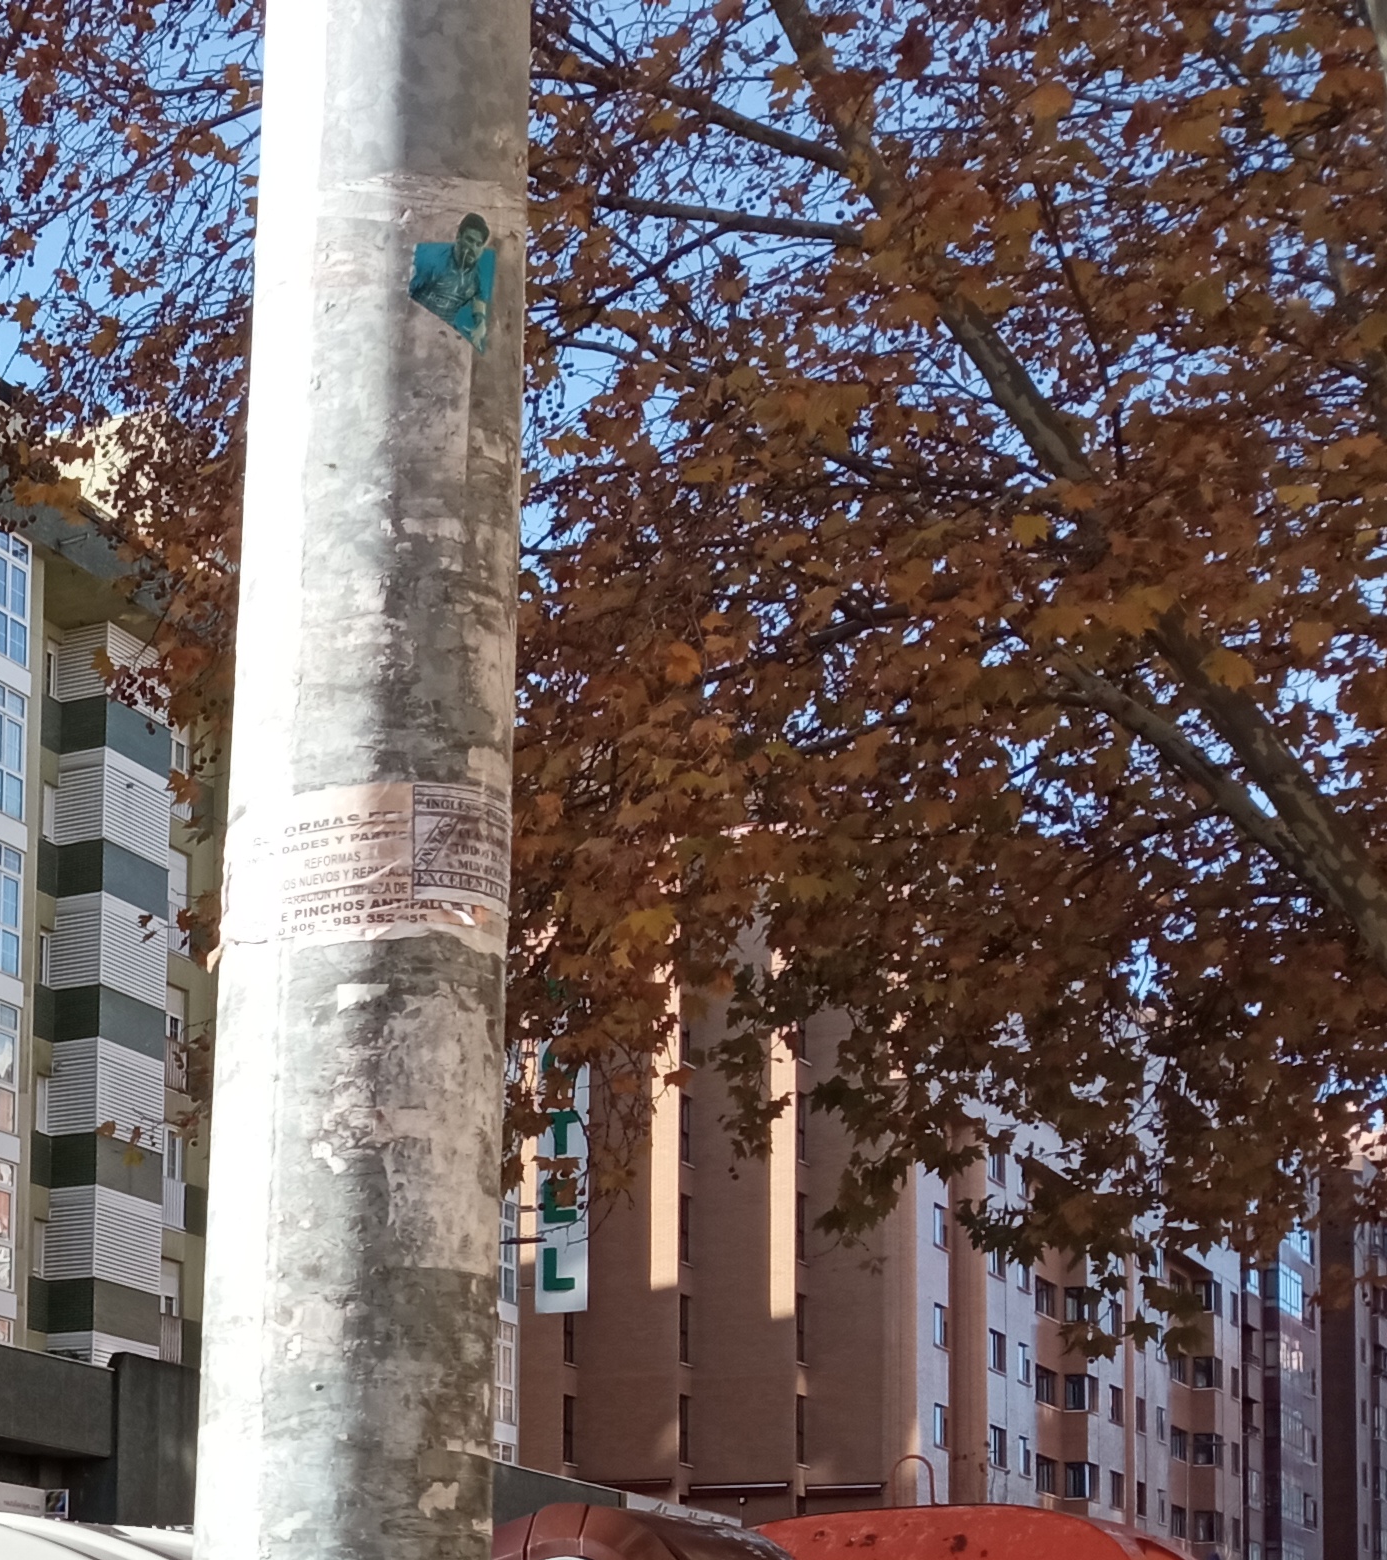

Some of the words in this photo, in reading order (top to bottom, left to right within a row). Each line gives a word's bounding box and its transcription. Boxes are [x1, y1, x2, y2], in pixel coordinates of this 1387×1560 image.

[334, 835, 345, 845] Y
[304, 851, 362, 870] REFORMAS
[299, 871, 340, 887] NUEVOS
[342, 867, 350, 878] Y
[394, 881, 409, 895] DE
[294, 900, 366, 920] PINCHOS
[333, 915, 362, 927] 983
[366, 912, 395, 924] 352
